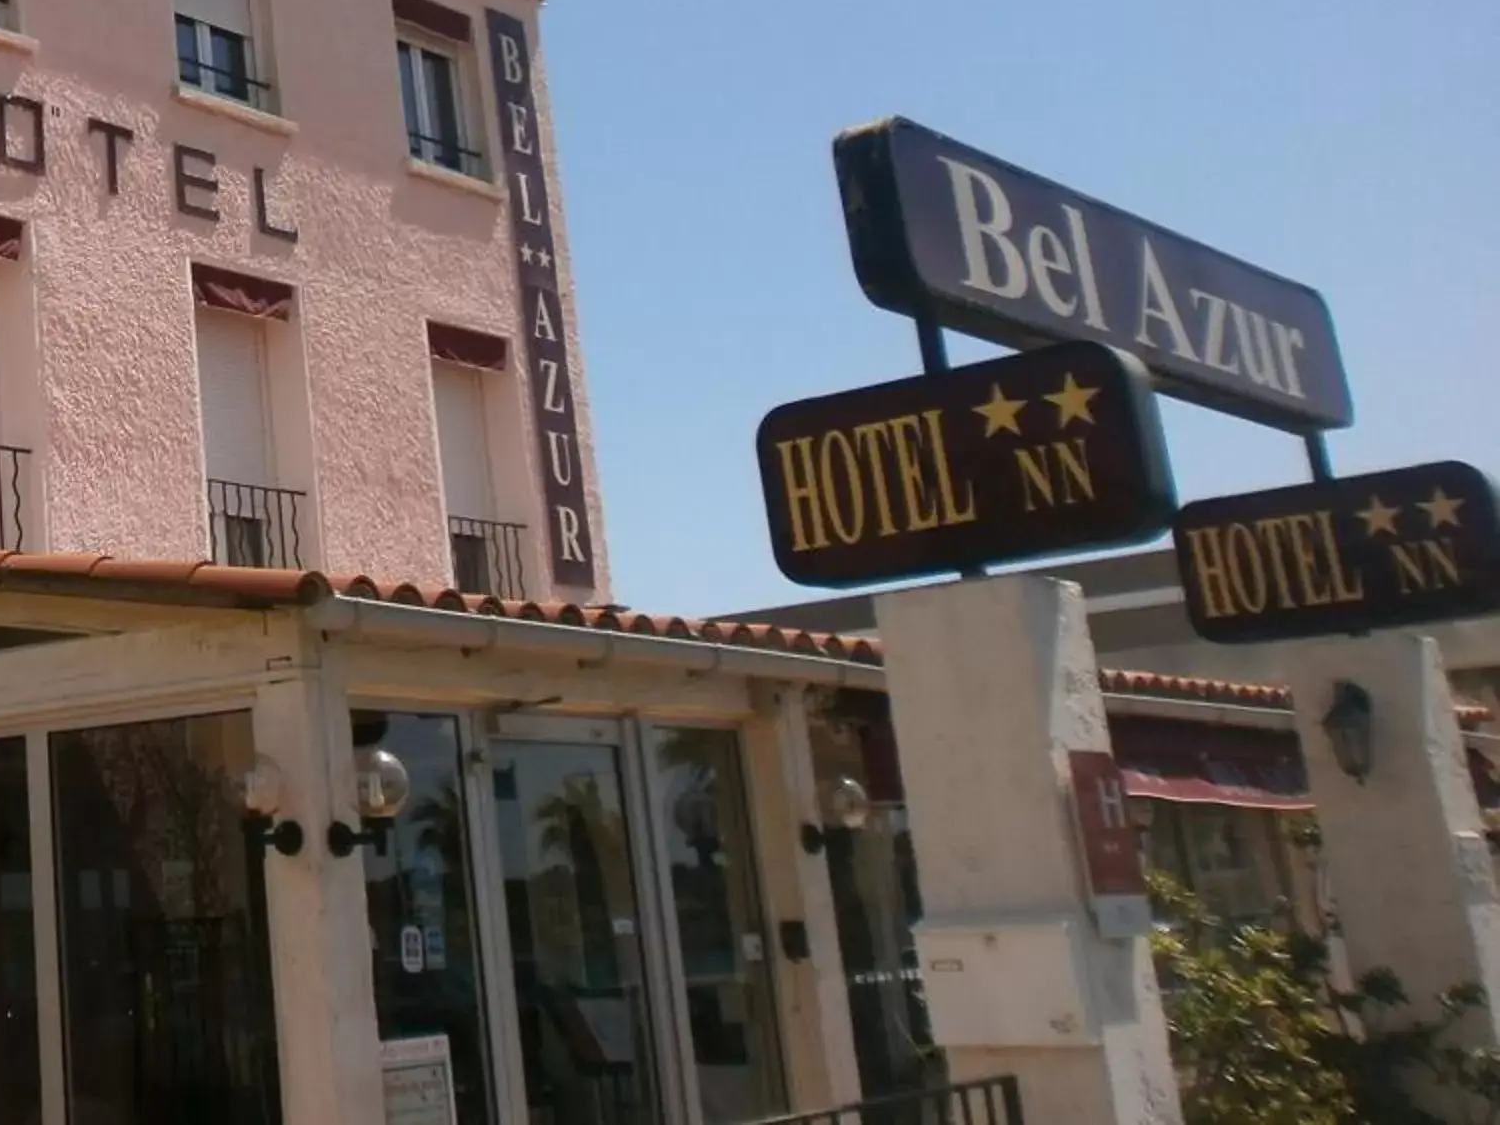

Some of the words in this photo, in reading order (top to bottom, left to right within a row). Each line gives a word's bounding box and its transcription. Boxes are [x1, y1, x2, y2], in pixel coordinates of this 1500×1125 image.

[499, 33, 541, 227] BEL
[533, 290, 586, 563] AZUR
[938, 156, 1110, 331] Bel
[1134, 234, 1306, 399] Azur
[775, 407, 977, 553] HOTEL
[1013, 439, 1096, 512] NN
[1186, 510, 1363, 618] HOTEL
[1390, 536, 1462, 595] NN
